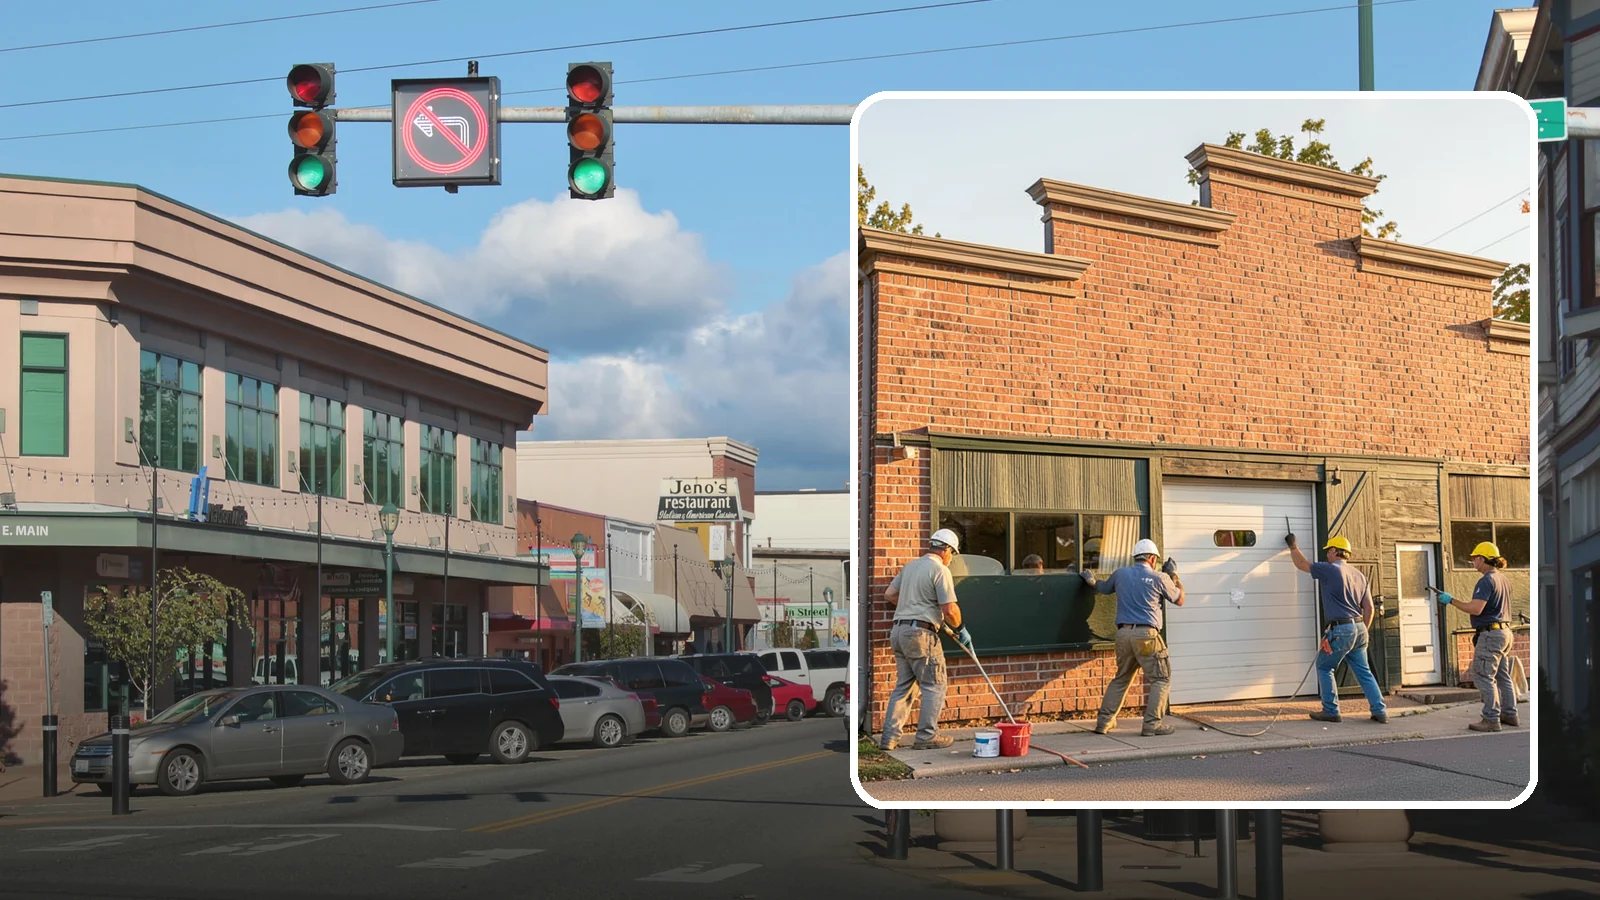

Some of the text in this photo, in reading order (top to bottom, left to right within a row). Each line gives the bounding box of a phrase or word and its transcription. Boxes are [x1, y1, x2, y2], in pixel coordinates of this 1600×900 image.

[669, 480, 727, 494] Jeno's
[665, 496, 731, 509] restaurant
[659, 510, 682, 519] Italian
[686, 510, 714, 519] American
[715, 510, 738, 519] Cuisine
[2, 525, 49, 536] E. MAIN
[797, 607, 829, 617] Street
